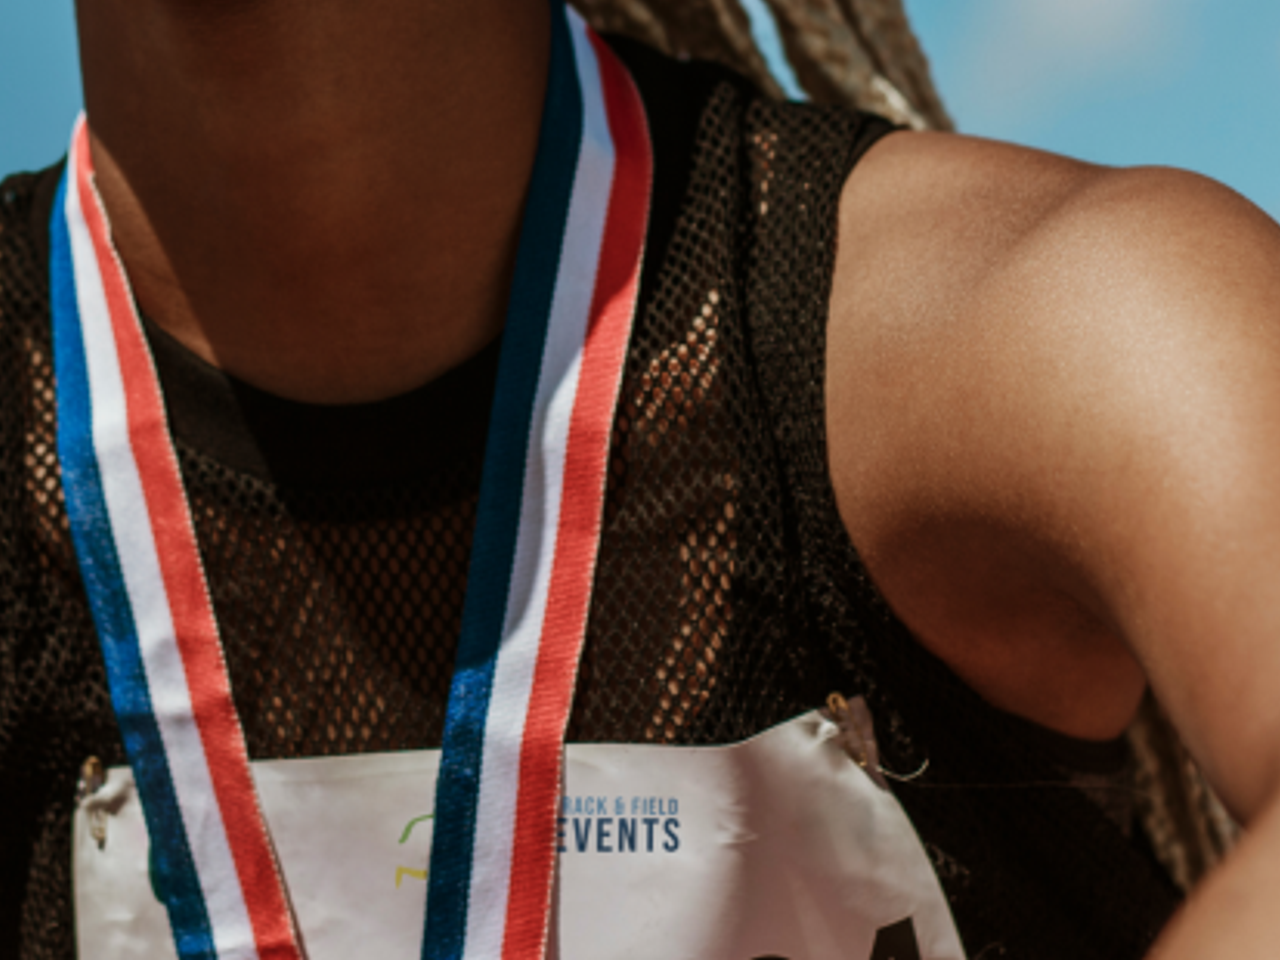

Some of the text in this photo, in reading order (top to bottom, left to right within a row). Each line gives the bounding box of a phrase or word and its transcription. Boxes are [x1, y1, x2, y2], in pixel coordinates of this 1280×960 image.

[562, 796, 679, 815] RACK & FIELD
[556, 817, 681, 853] EVENTS
